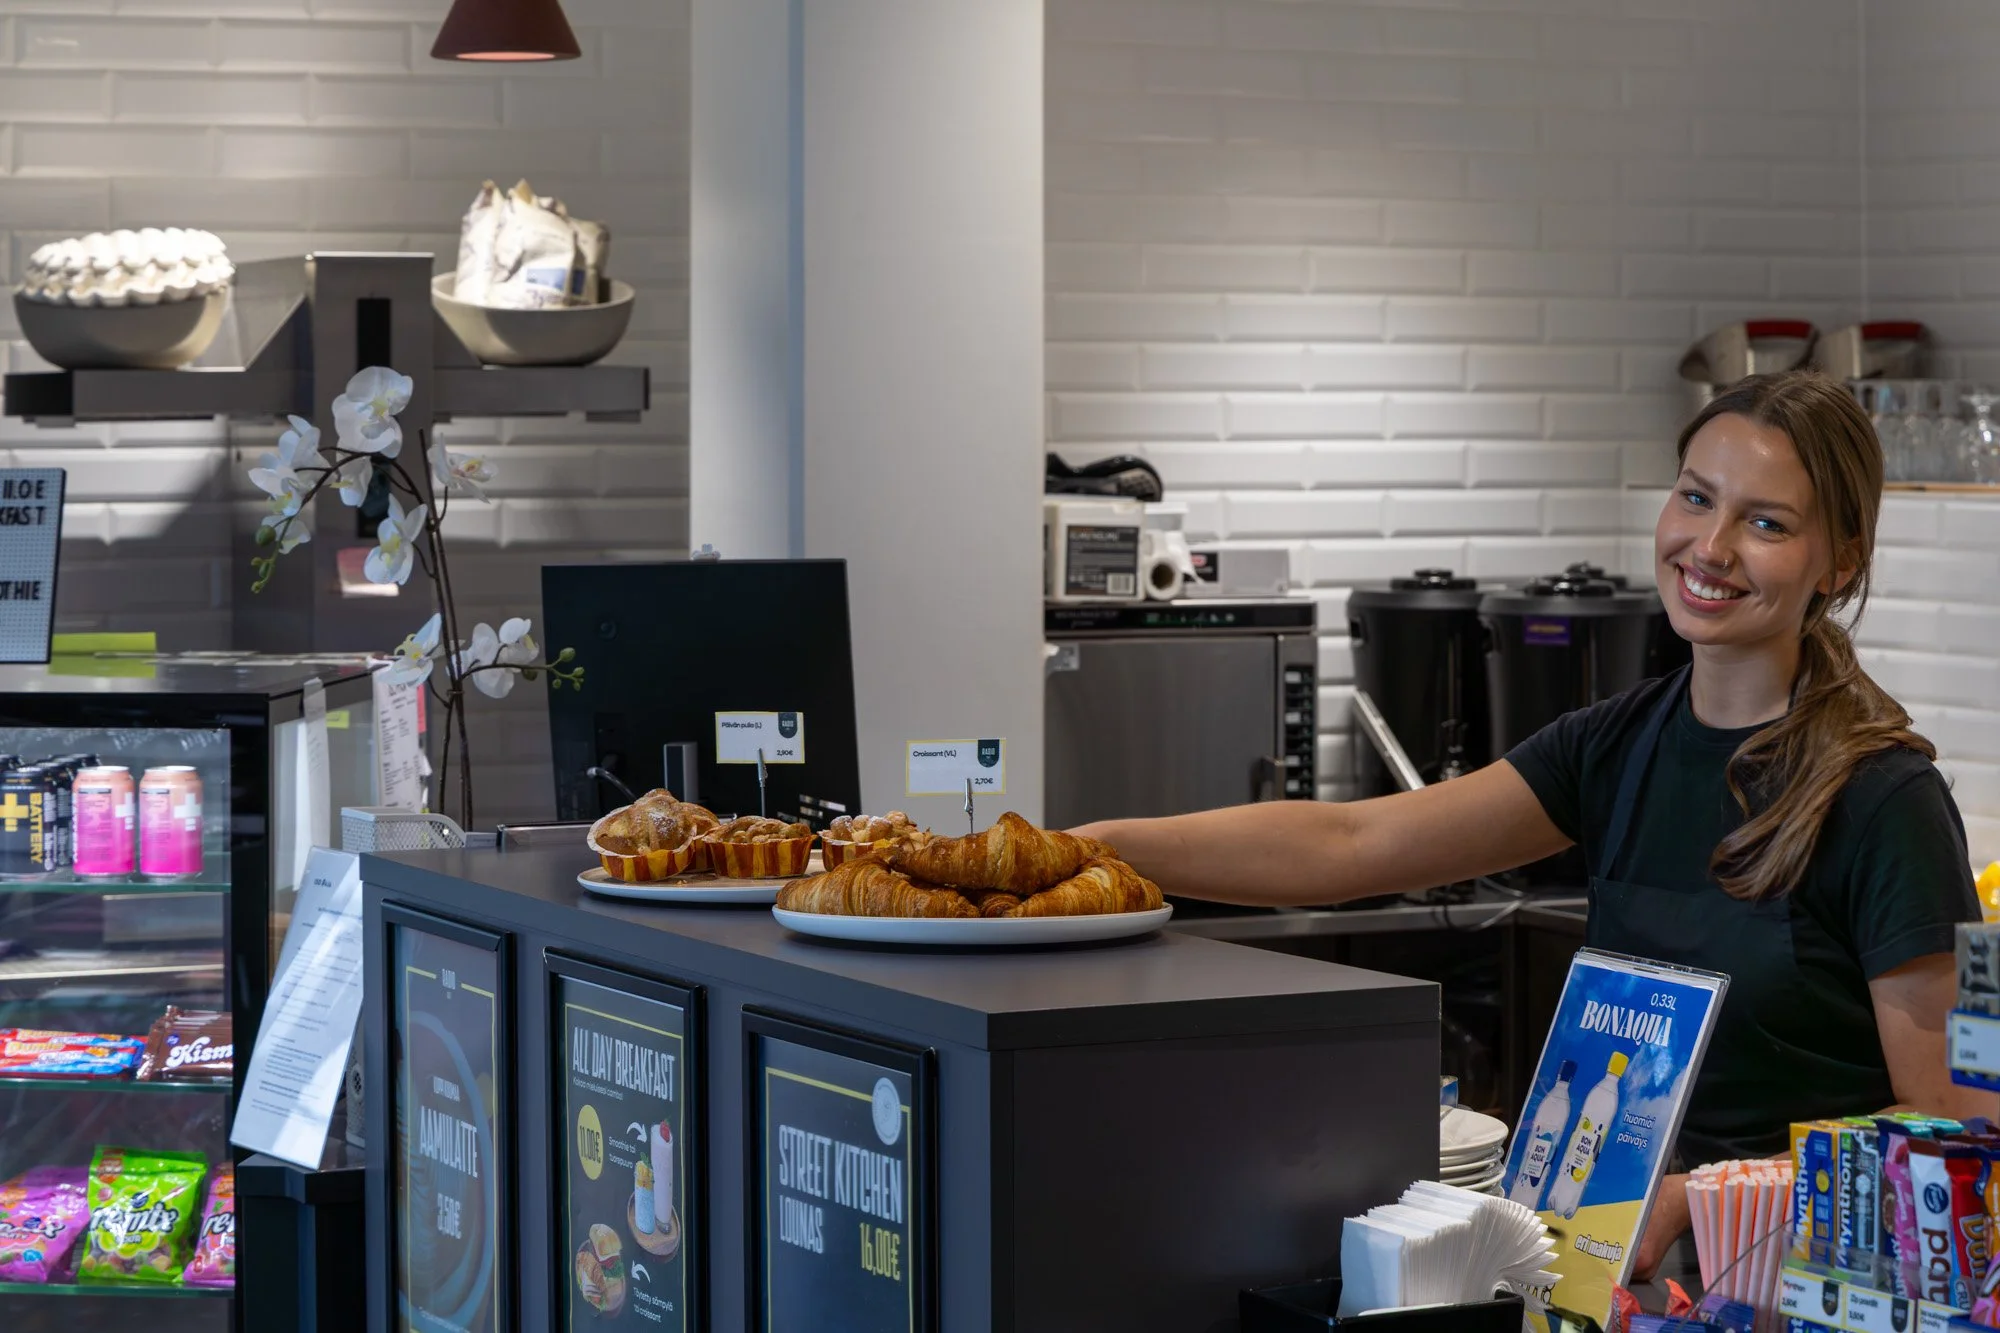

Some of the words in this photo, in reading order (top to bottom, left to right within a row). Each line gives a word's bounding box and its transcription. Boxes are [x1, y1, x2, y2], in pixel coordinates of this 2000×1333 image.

[944, 749, 957, 758] (VL)
[29, 792, 43, 864] BATTERY
[1579, 999, 1673, 1048] BONAQUA
[1650, 992, 1676, 1011] 0,33L
[573, 1027, 590, 1076] ALL
[592, 1032, 613, 1082] DAY
[615, 1039, 676, 1102] BREAKFAST
[419, 1105, 478, 1178] AAMULATTE
[608, 1136, 629, 1152] Smoothie
[1616, 1132, 1649, 1150] päiväys
[779, 1124, 832, 1200] STREET
[834, 1140, 902, 1225] KITCHEN
[90, 1200, 179, 1234] remix
[779, 1195, 823, 1254] LOUNAS
[1836, 1152, 1853, 1266] Mynthon
[1574, 1234, 1591, 1253] eri
[1589, 1239, 1624, 1265] makuja
